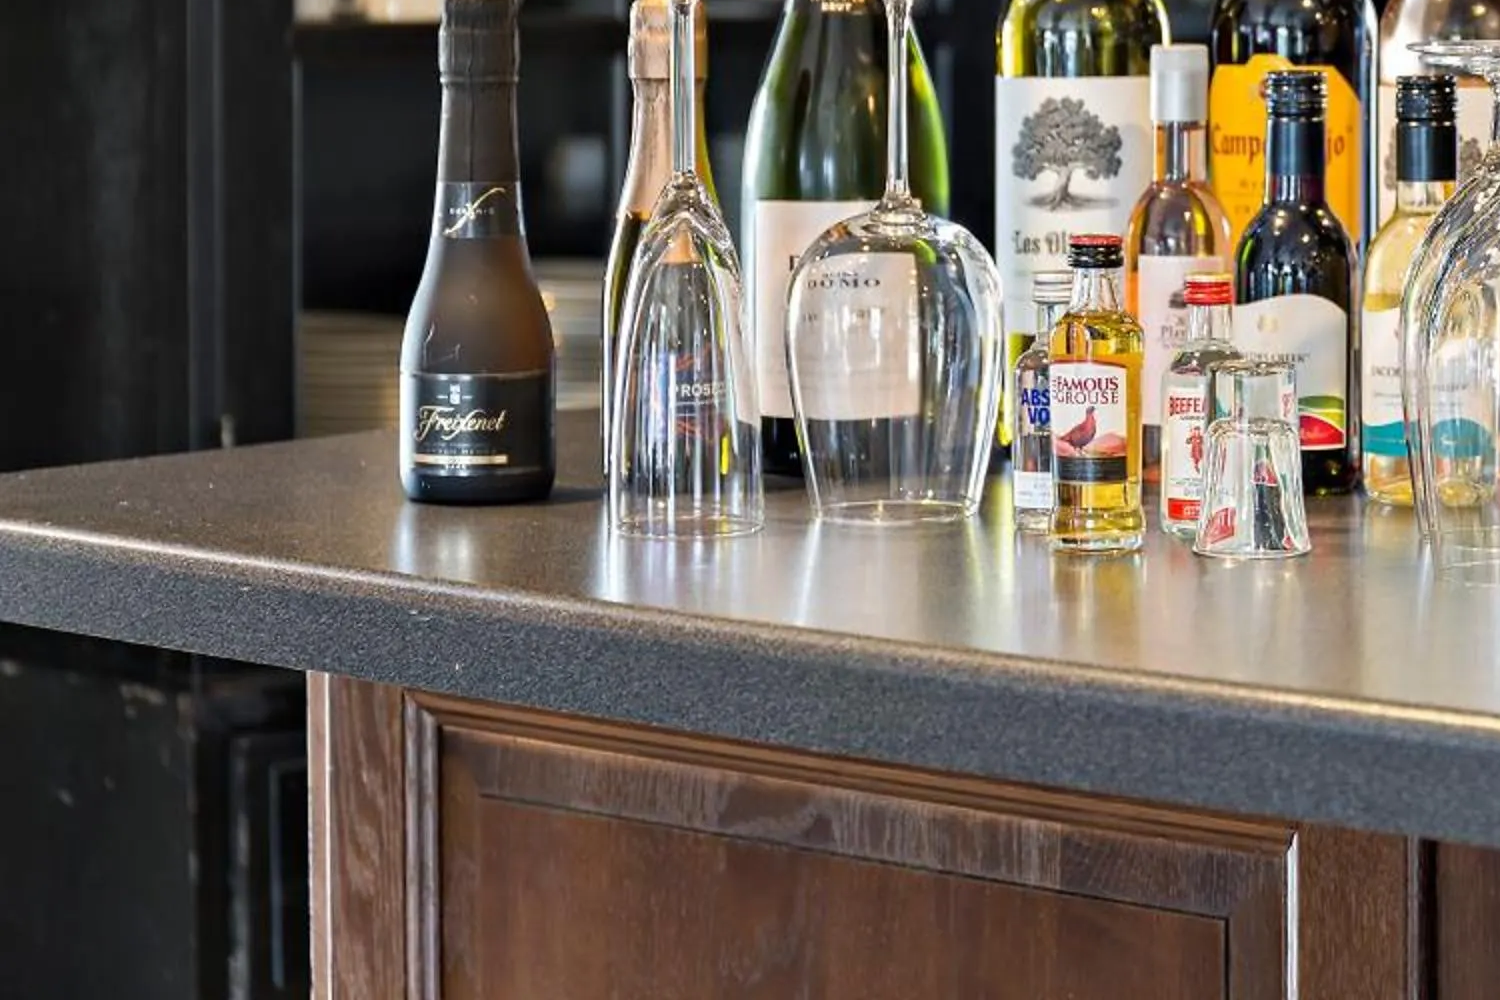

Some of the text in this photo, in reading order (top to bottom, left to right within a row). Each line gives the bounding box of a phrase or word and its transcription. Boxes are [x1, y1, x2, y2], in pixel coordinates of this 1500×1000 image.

[1211, 123, 1267, 165] Camp
[1057, 376, 1119, 391] FAMOUS
[1021, 388, 1050, 406] ABS
[1056, 390, 1119, 405] GROUSE
[413, 405, 507, 441] Freixenet
[1027, 407, 1050, 425] VO
